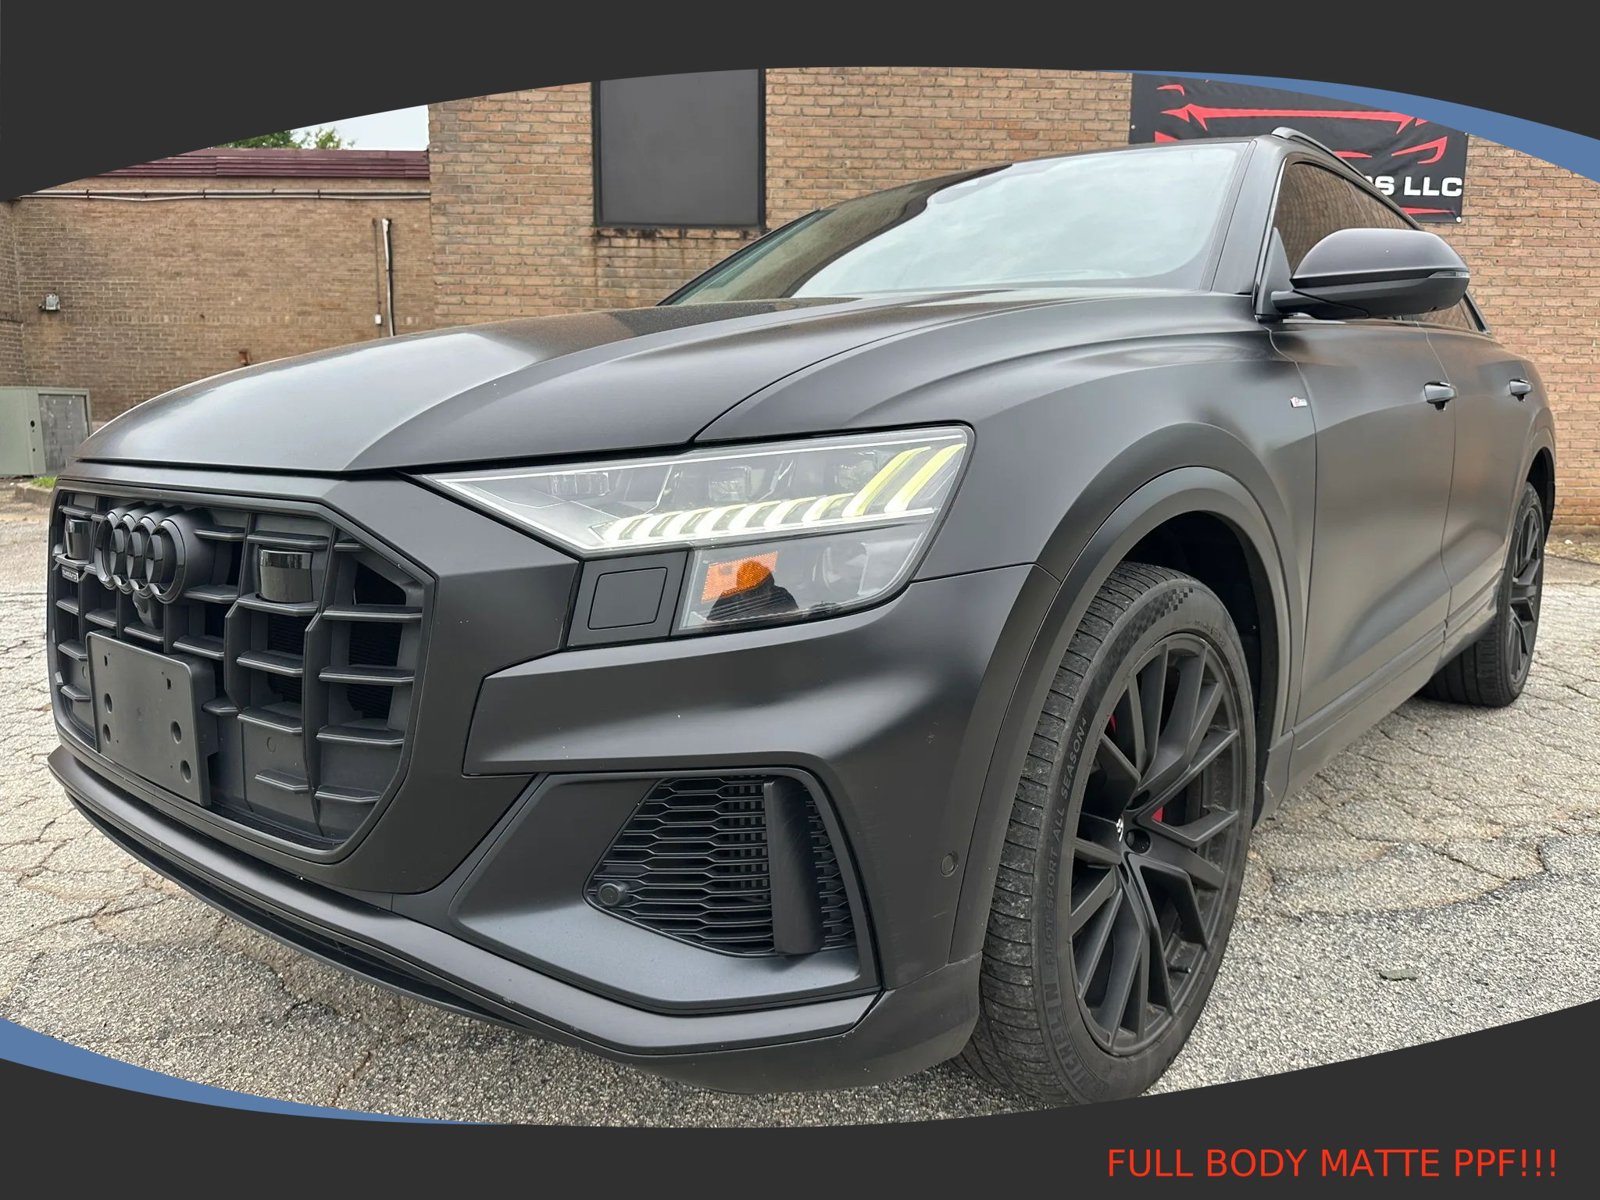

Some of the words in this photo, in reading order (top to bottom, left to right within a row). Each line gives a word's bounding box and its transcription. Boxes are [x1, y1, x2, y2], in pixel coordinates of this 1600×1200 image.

[1403, 176, 1463, 197] LLC
[1046, 846, 1058, 910] SPORT
[1053, 807, 1065, 843] ALL
